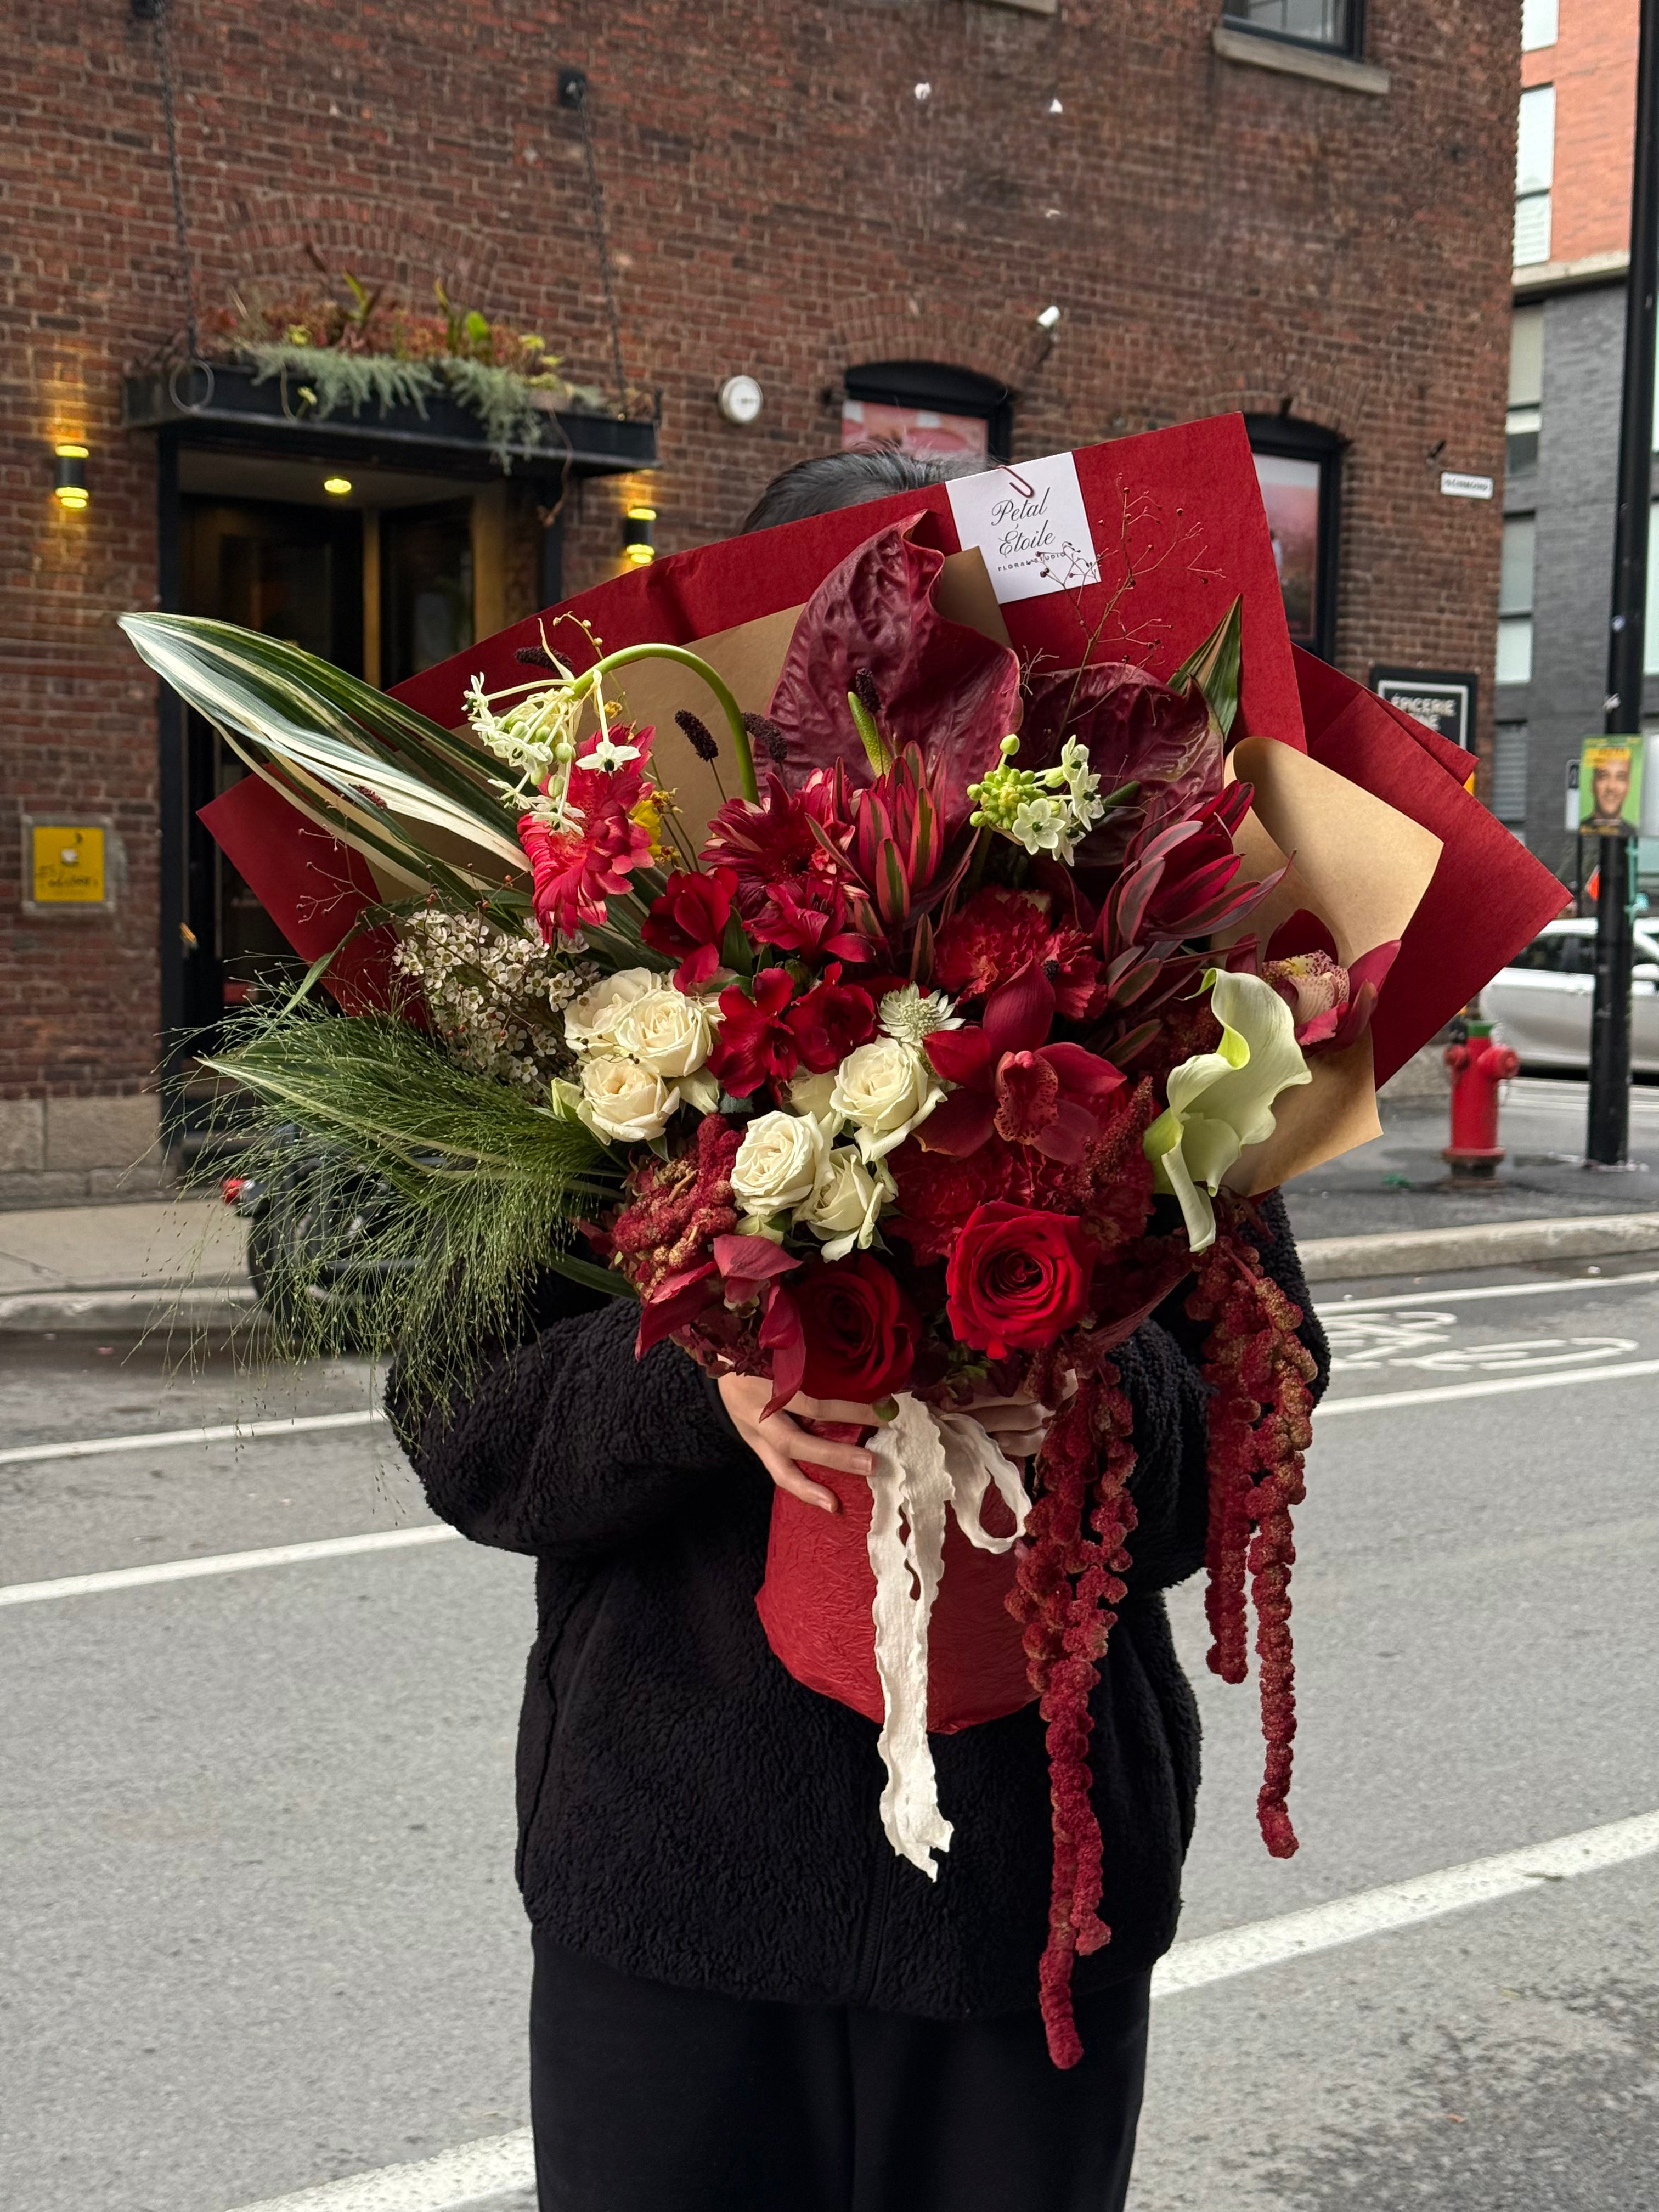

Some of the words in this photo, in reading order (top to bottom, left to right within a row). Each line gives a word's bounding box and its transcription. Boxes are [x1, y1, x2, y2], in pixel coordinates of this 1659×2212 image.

[991, 487, 1050, 526] Petal
[998, 519, 1055, 558] Étoile
[998, 560, 1031, 572] FLORAL
[1034, 552, 1065, 563] STUDIO
